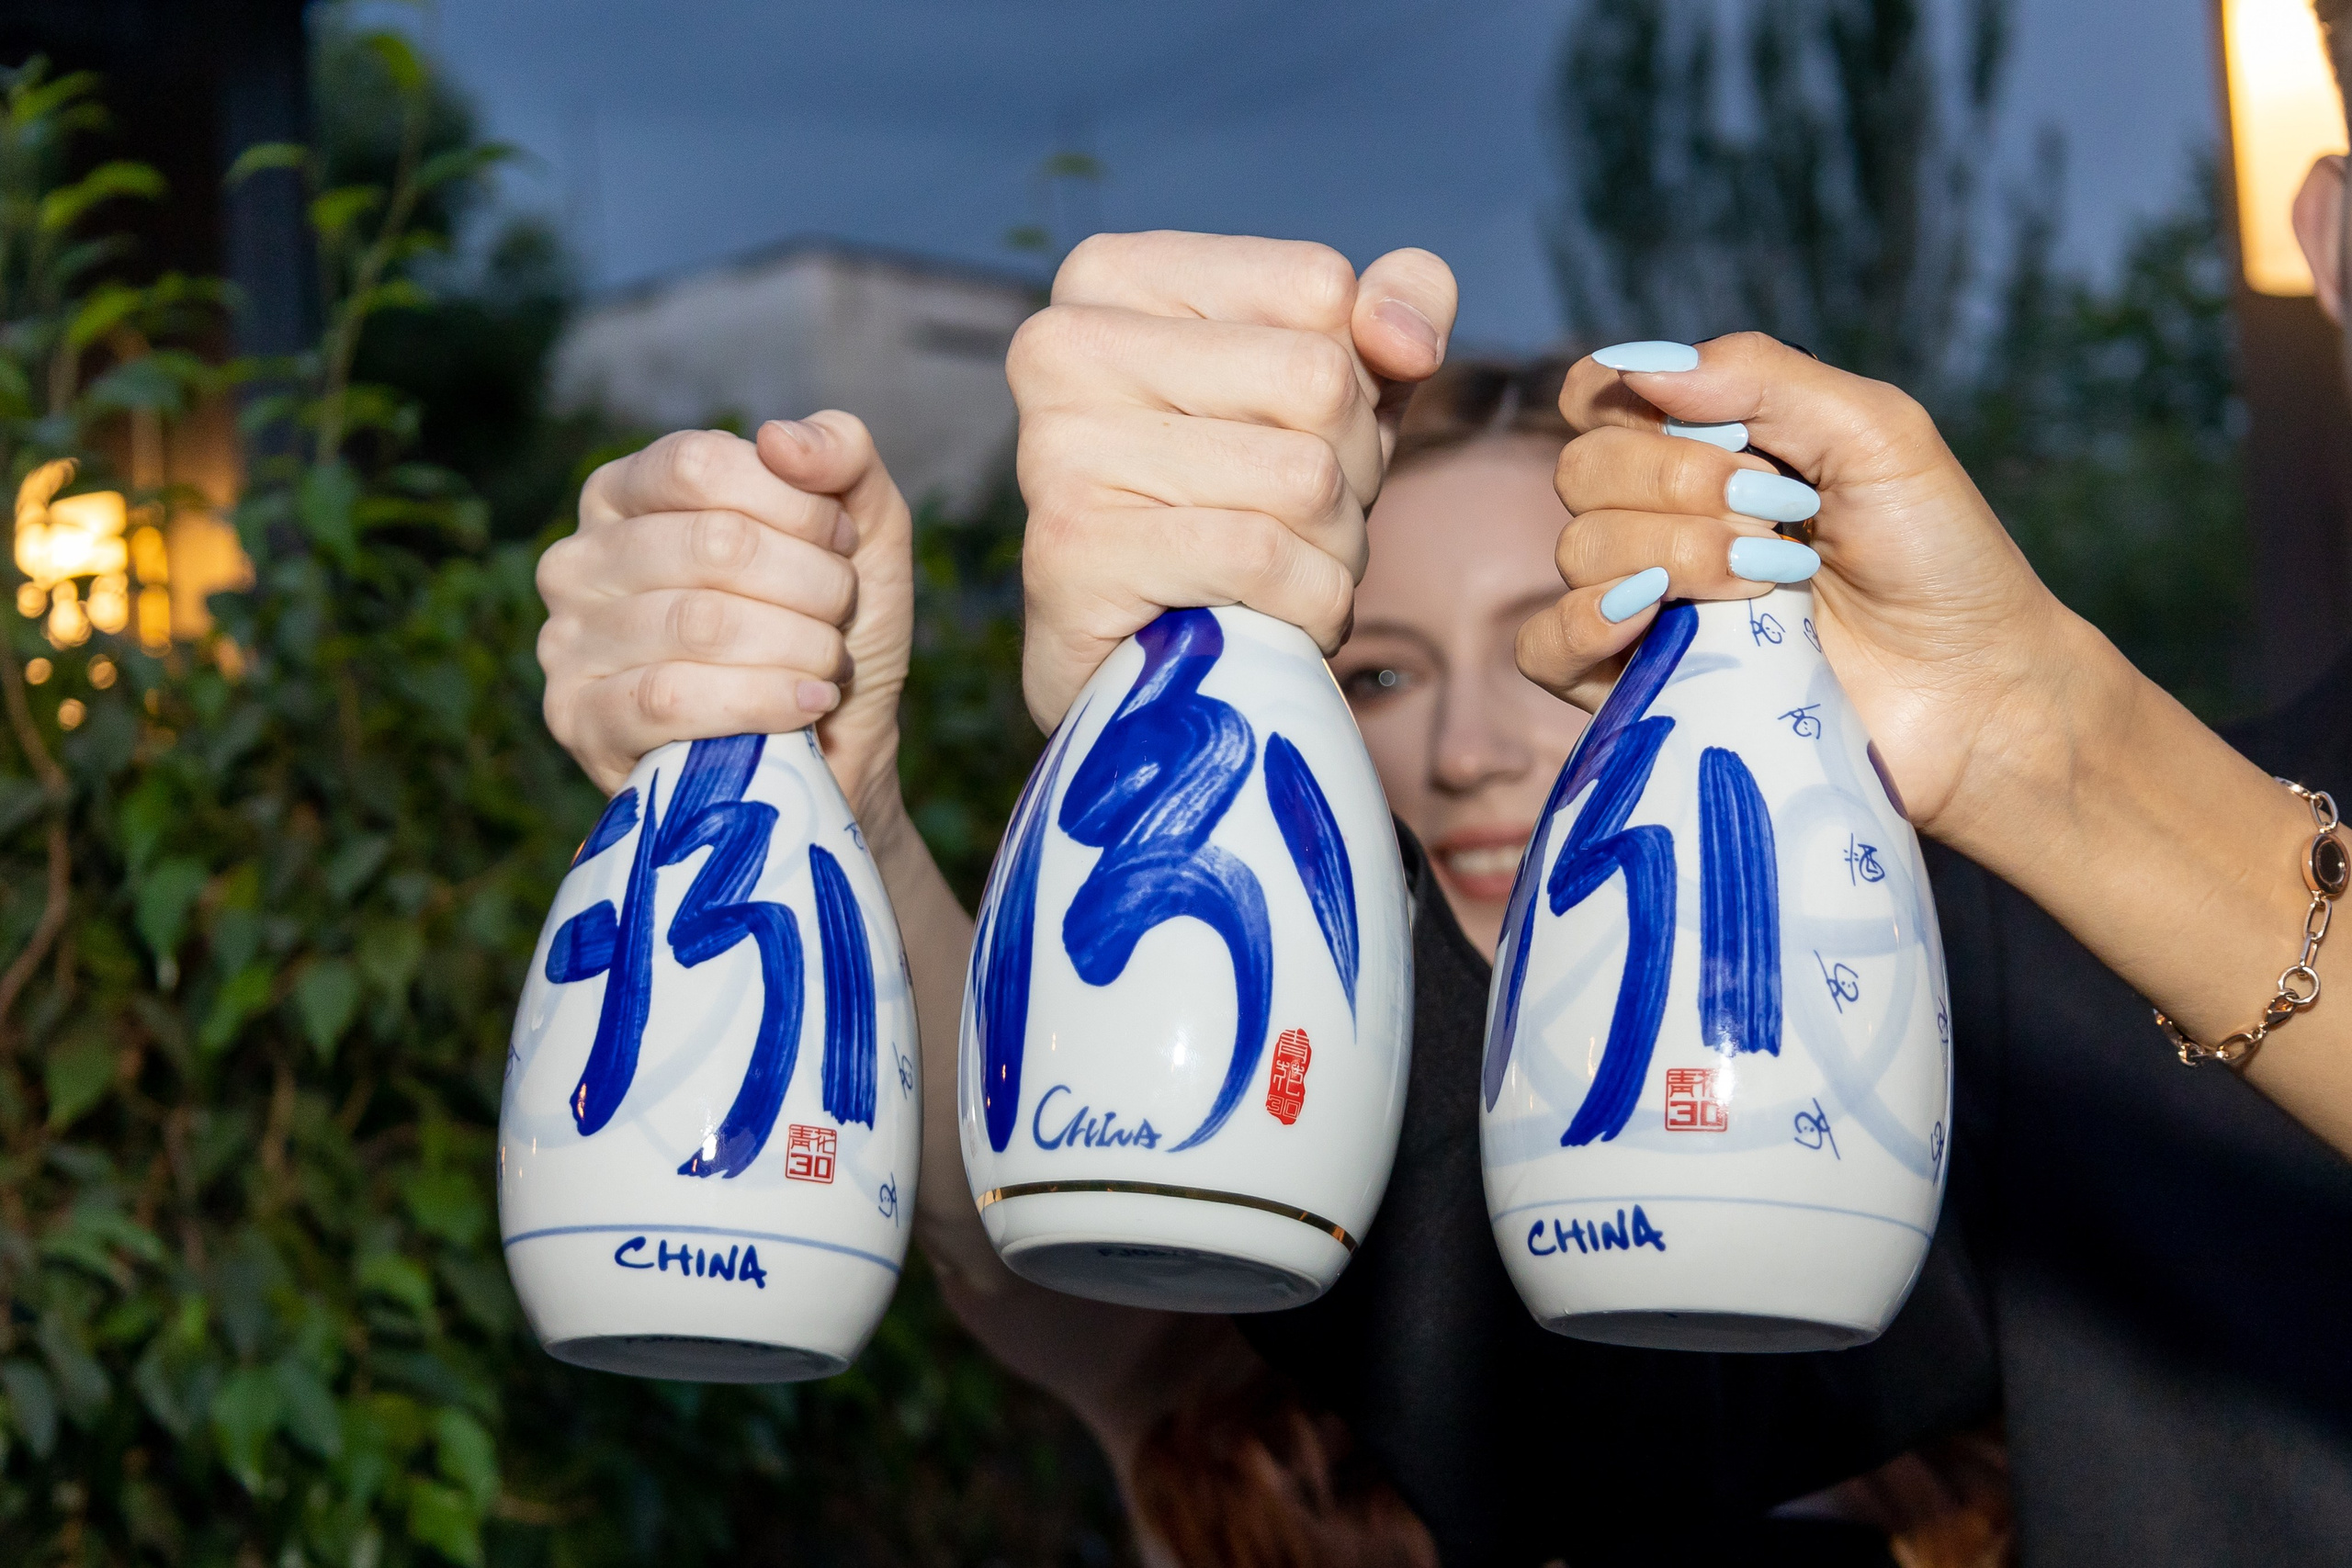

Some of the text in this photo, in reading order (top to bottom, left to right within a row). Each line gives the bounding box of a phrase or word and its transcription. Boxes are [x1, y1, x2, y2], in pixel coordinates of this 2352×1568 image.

[1669, 1100, 1724, 1126] 30
[789, 1124, 836, 1155] 青花
[789, 1152, 832, 1179] 30
[1528, 1204, 1666, 1256] CHINA
[615, 1235, 767, 1289] CHINA
